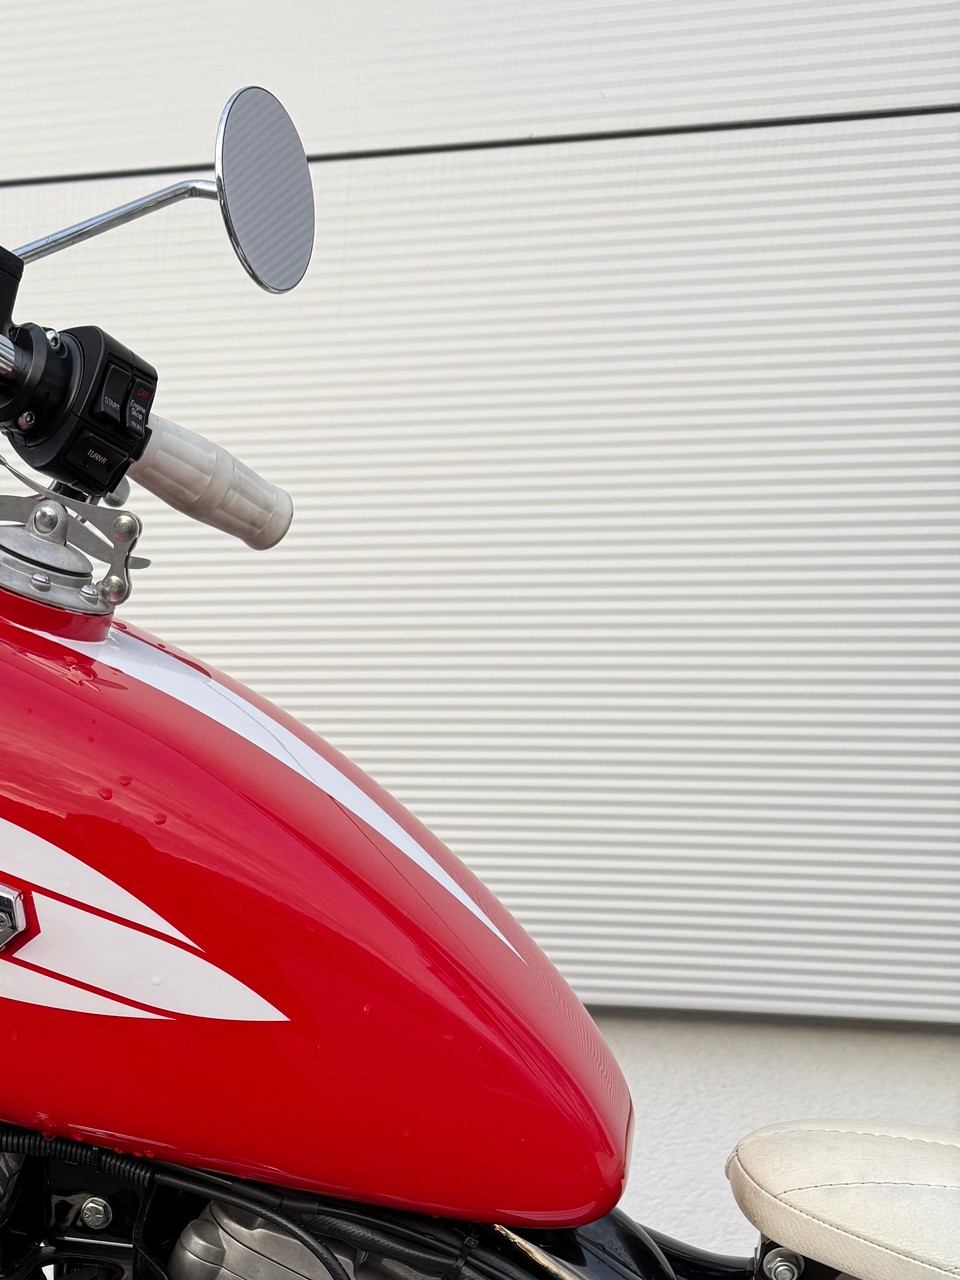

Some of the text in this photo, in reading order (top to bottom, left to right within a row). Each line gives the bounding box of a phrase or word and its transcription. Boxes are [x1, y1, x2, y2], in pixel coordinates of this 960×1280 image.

[137, 388, 150, 398] OFF
[104, 396, 120, 410] START
[129, 399, 146, 415] Engine
[130, 407, 143, 420] Stop
